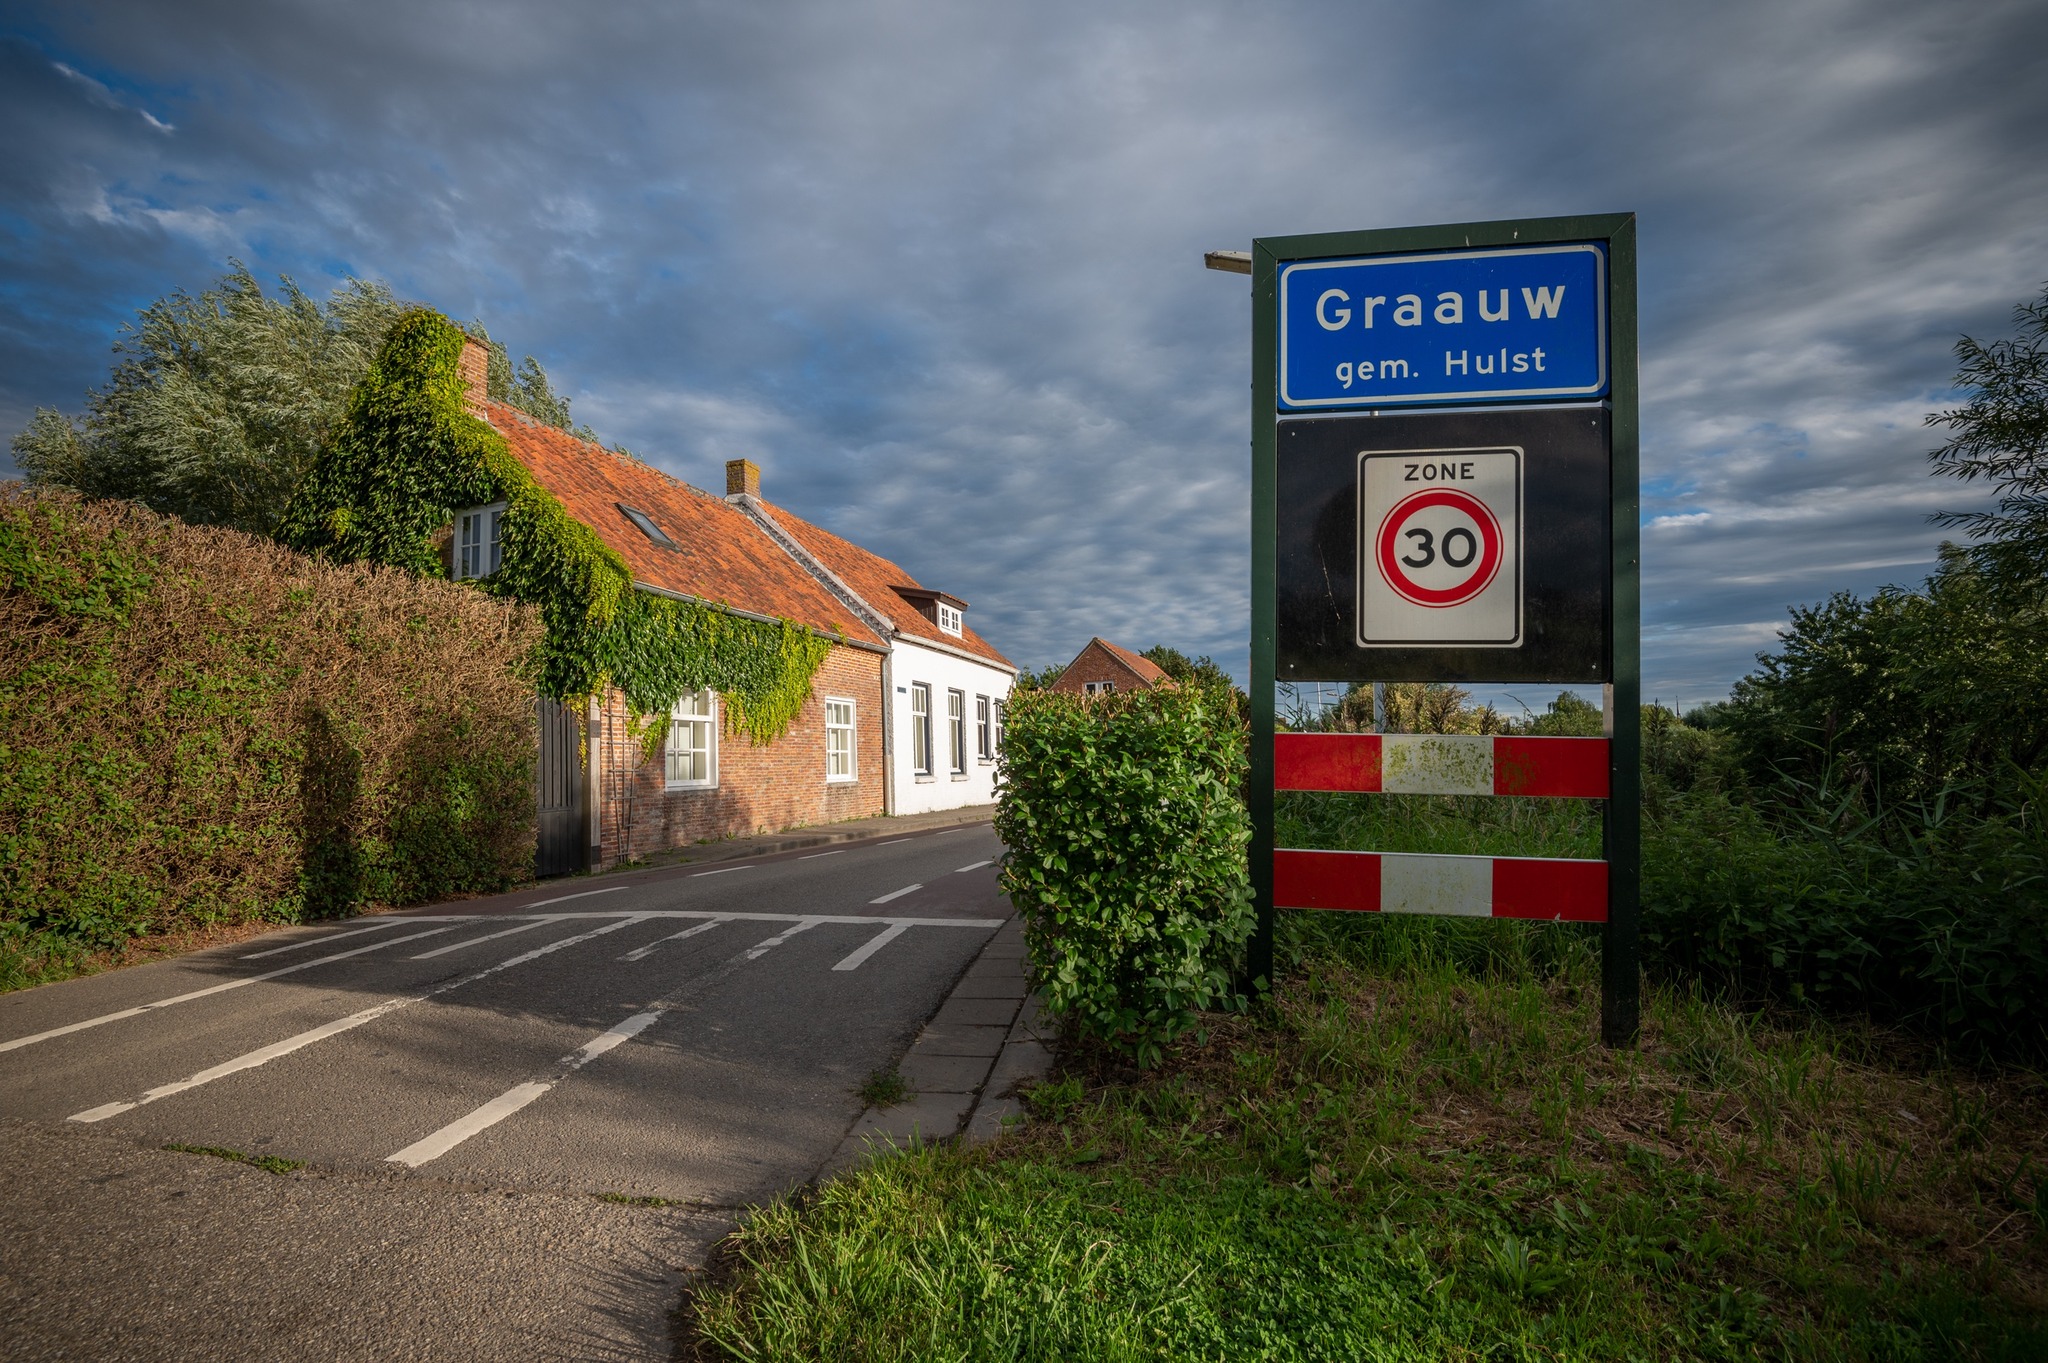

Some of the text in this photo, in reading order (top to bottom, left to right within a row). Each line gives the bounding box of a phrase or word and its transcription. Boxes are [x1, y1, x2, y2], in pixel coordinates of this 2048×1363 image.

[1315, 285, 1566, 331] Graauw
[1335, 347, 1546, 389] gem. Hulst
[1404, 462, 1475, 482] ZONE
[1401, 527, 1477, 569] 30
